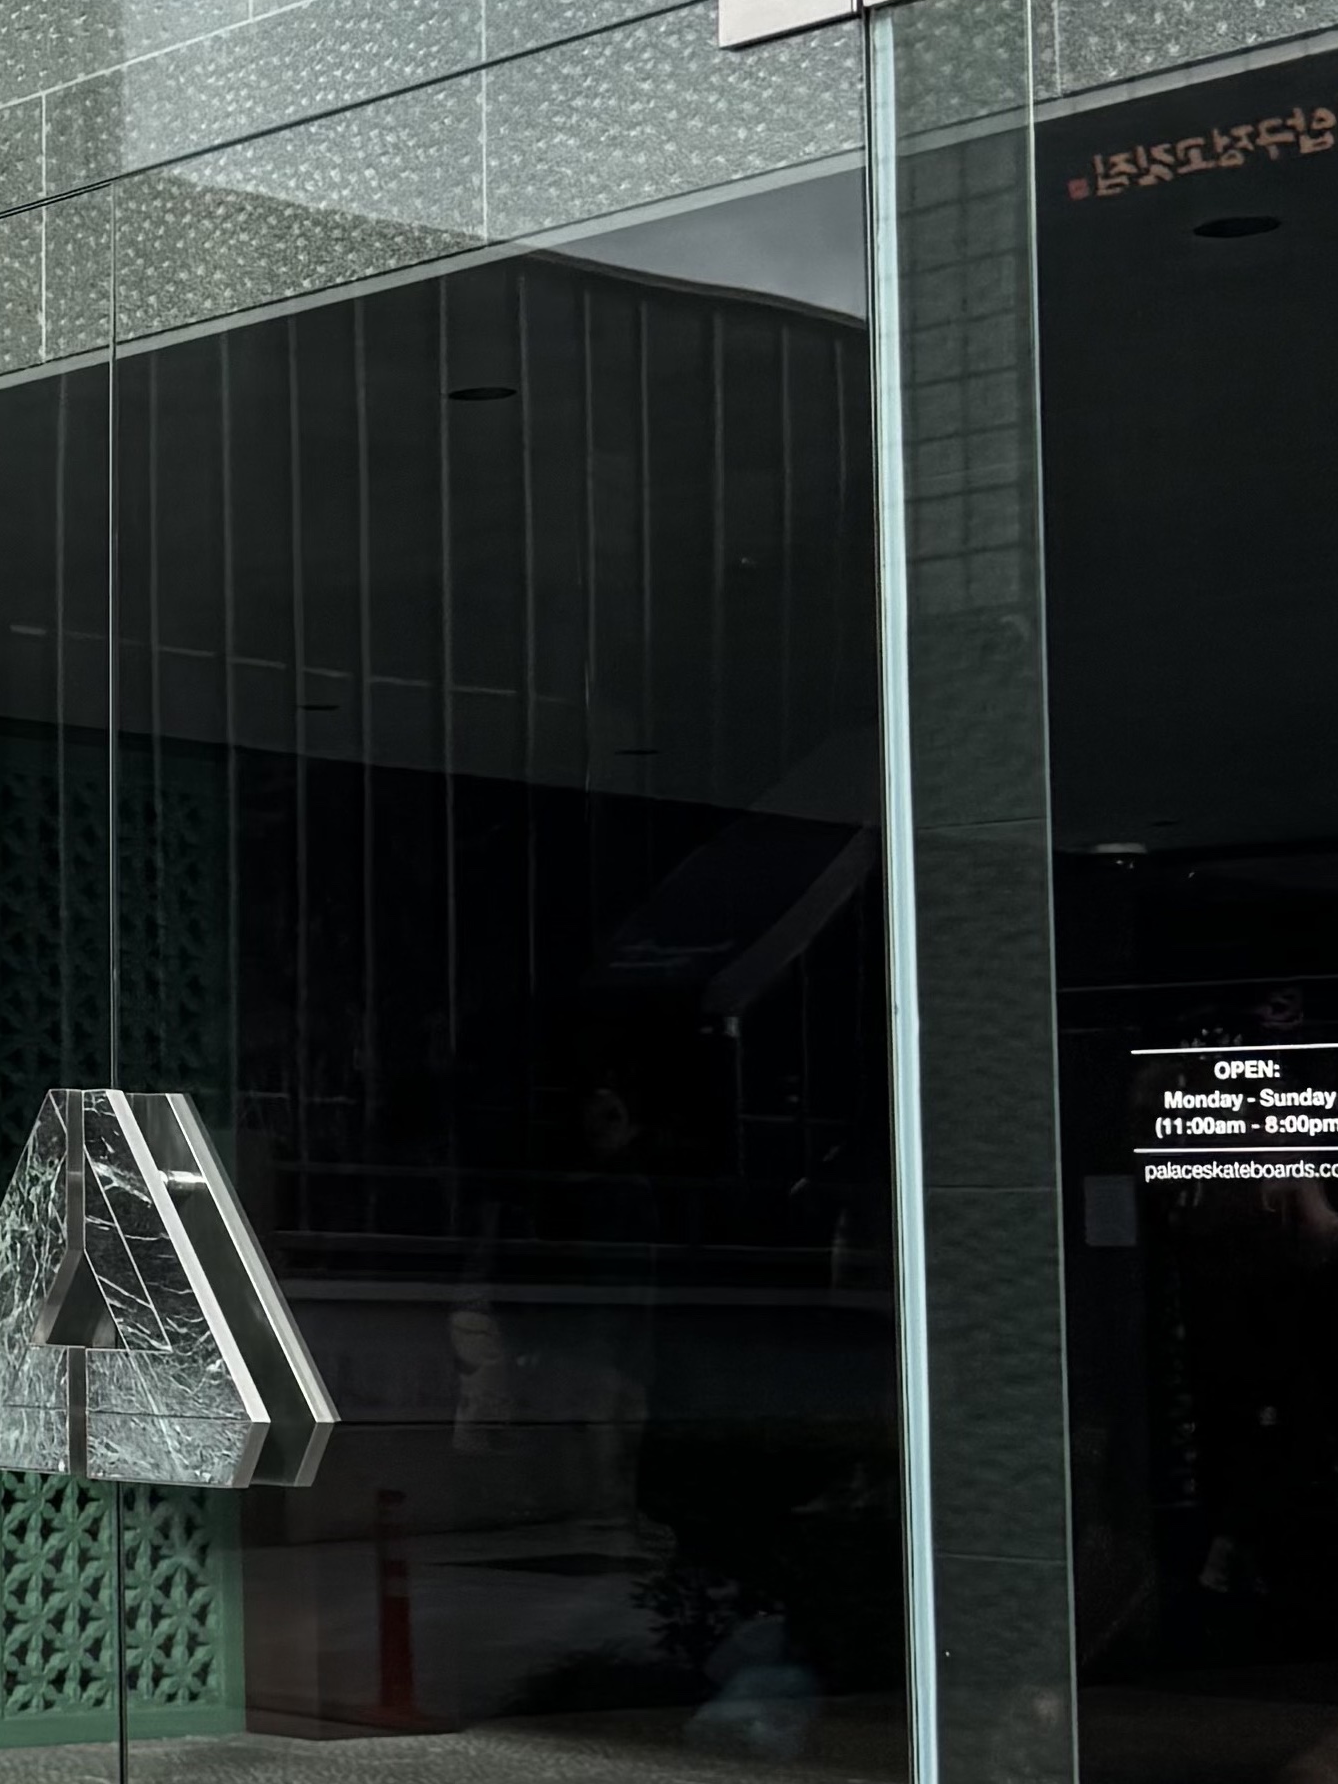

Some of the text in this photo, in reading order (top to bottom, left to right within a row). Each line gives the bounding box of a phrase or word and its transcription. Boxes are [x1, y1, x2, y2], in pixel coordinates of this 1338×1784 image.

[1213, 1060, 1281, 1080] OPEN:
[1163, 1089, 1244, 1112] Monday
[1259, 1087, 1337, 1110] Sunday
[1155, 1116, 1247, 1139] (11:00am
